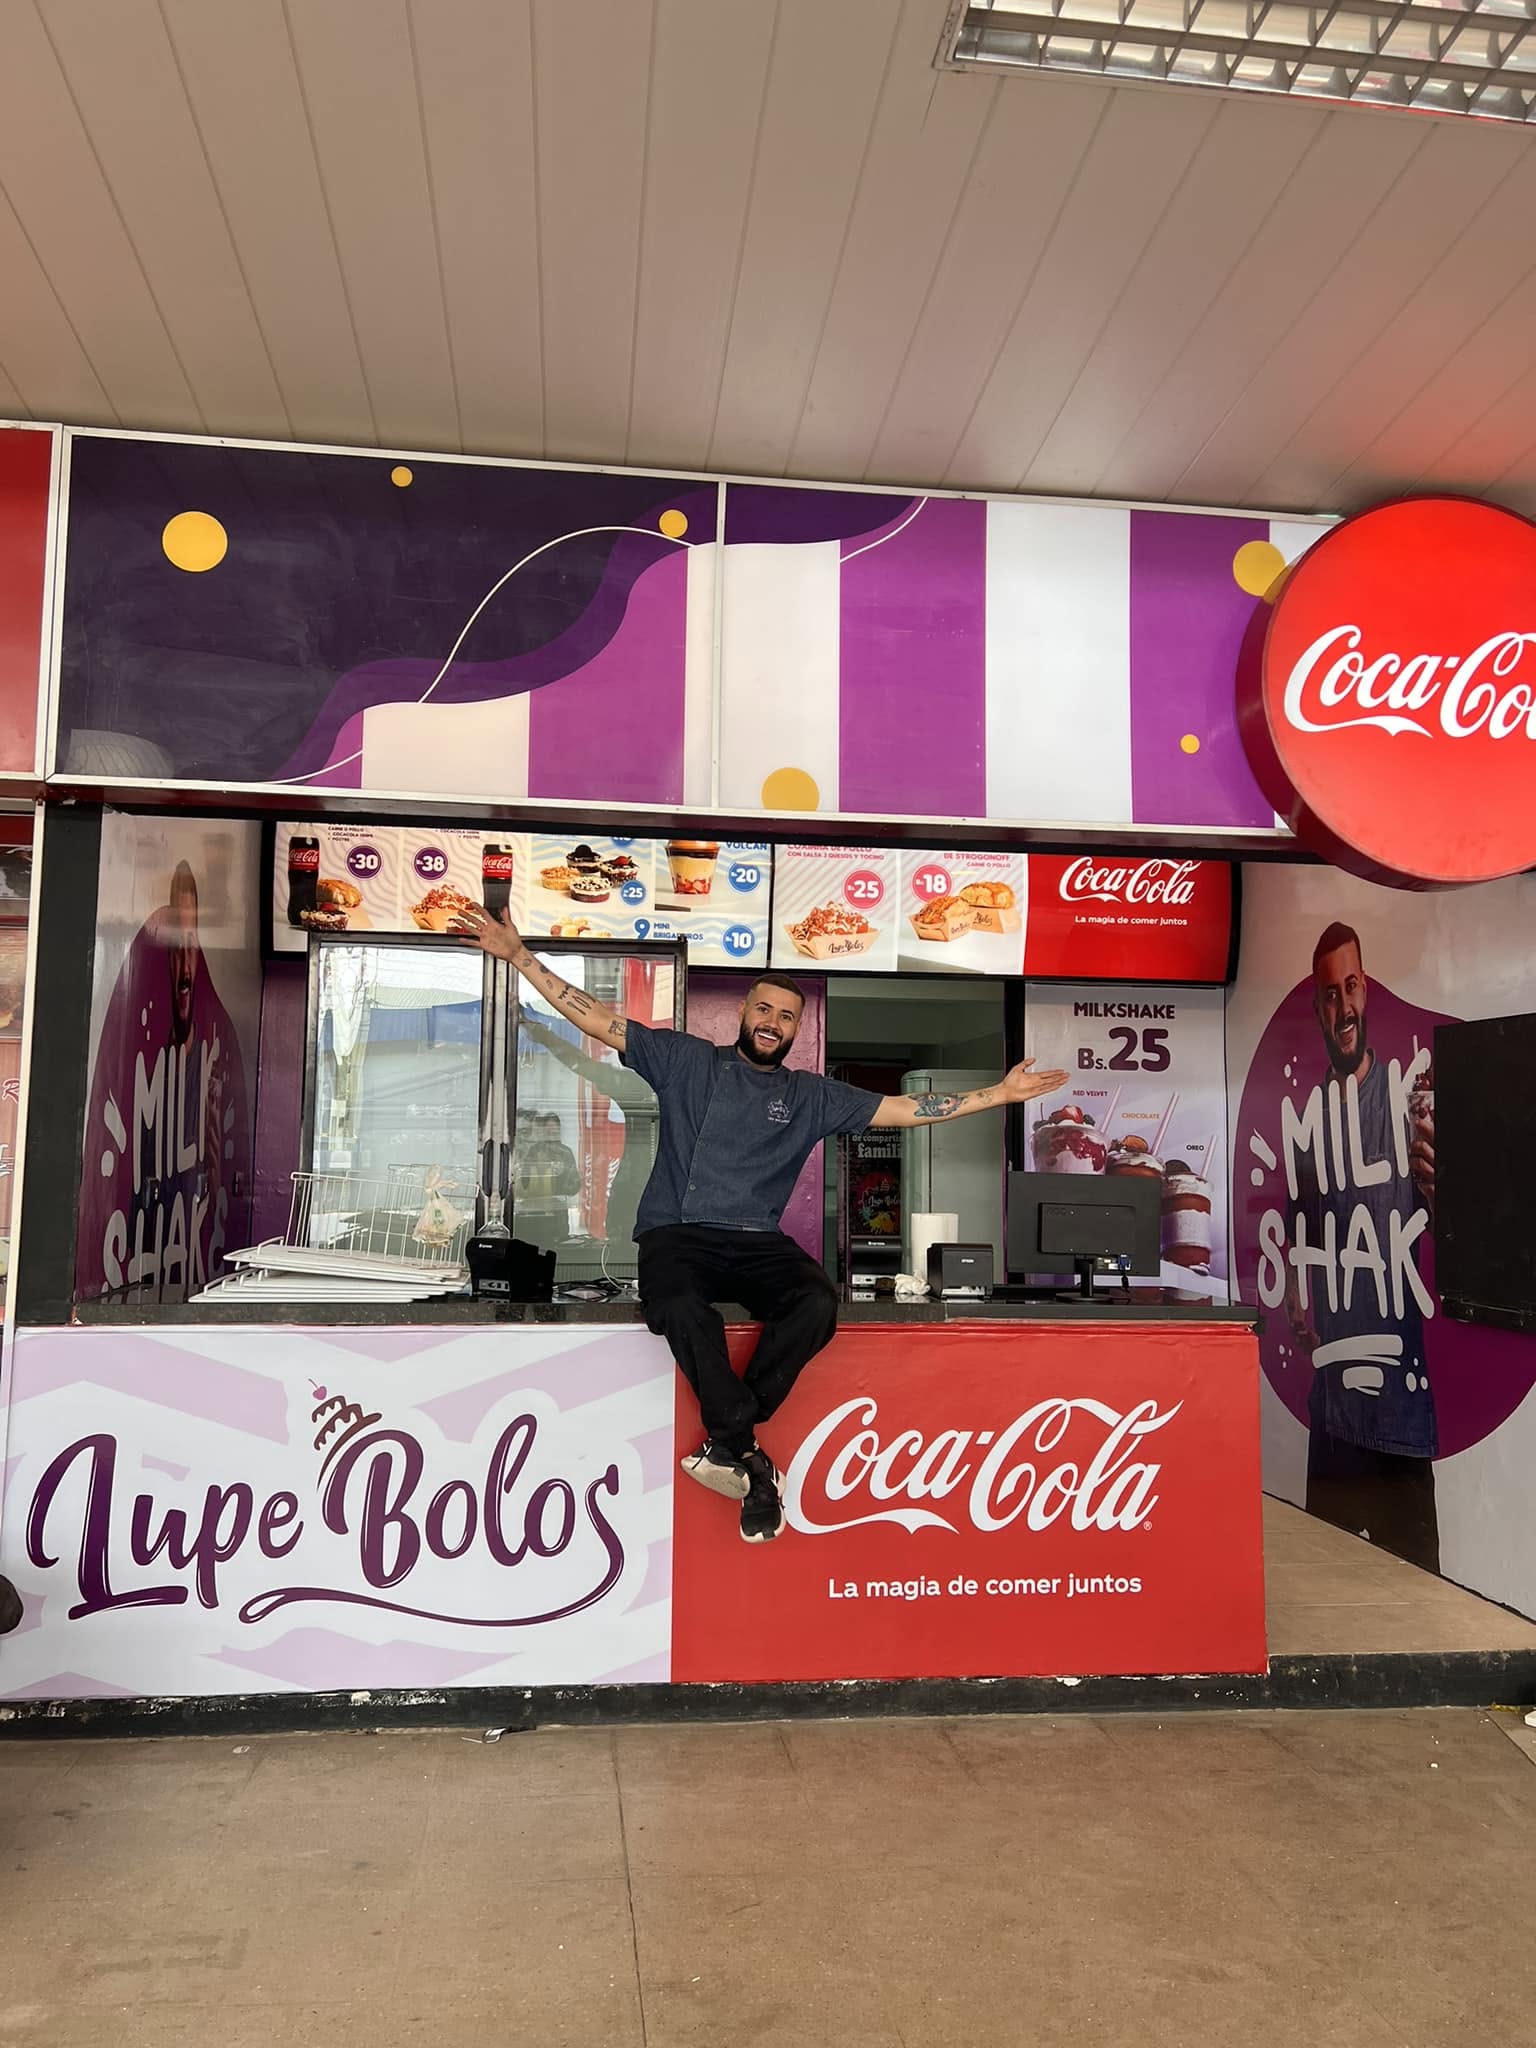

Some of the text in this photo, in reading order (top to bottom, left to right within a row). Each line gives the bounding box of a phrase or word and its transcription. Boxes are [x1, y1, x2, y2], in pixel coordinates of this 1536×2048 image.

[1284, 624, 1536, 740] Coca-Co
[1059, 856, 1202, 904] Coca-Cola
[1074, 915, 1188, 926] La magia de comer juntos
[1074, 1002, 1175, 1019] MILKSHAKE
[133, 1038, 221, 1195] MILK
[1280, 1047, 1431, 1201] MILK
[26, 1413, 624, 1627] Lupe Bolos
[782, 1396, 1184, 1535] Coca-Cola
[828, 1572, 1142, 1601] La magia de comer juntos
